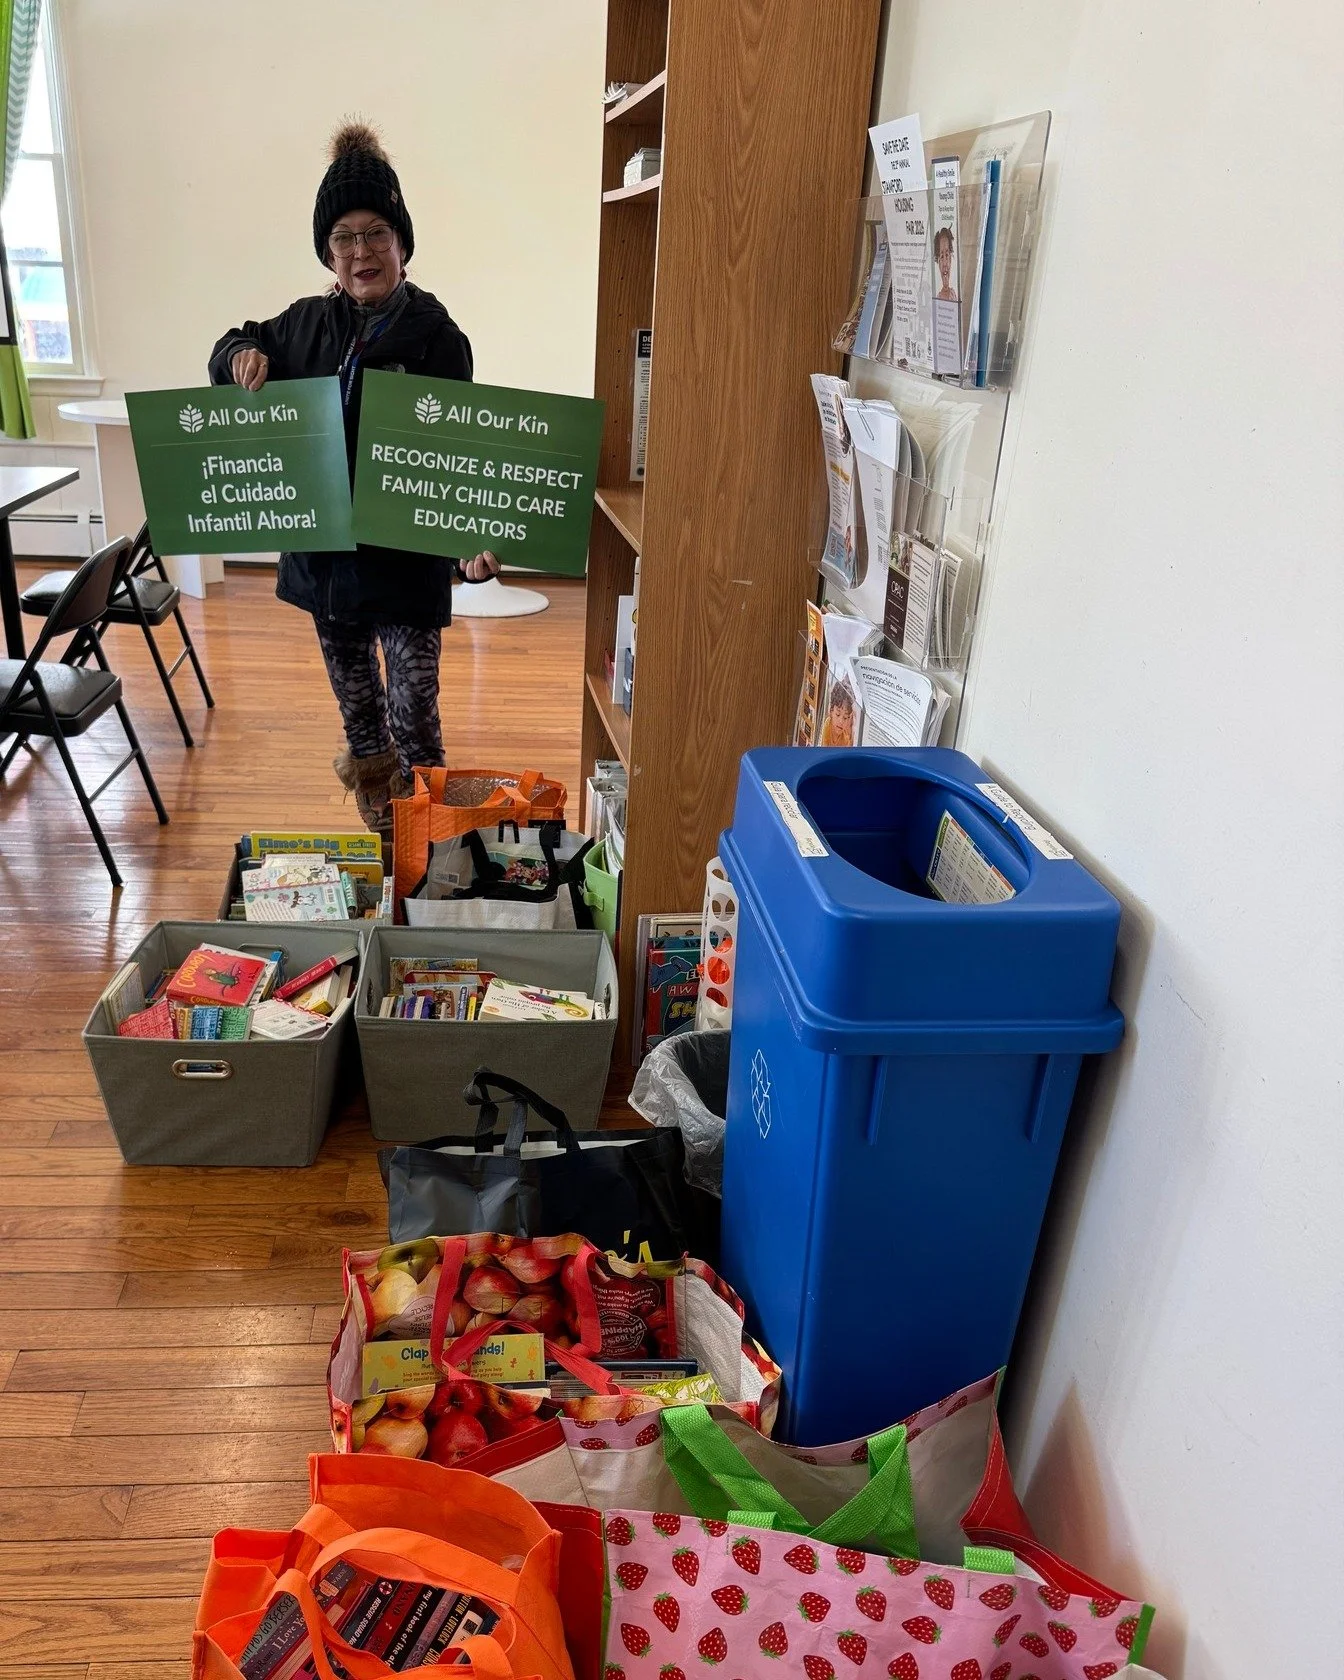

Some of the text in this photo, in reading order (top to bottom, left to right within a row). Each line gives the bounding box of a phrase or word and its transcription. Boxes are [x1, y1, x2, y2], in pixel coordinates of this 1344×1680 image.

[894, 197, 914, 213] HOUSING
[208, 405, 298, 427] All Our Kin
[446, 405, 549, 436] All Our Kin
[202, 453, 283, 480] ¡Financia
[371, 443, 583, 491] RECOGNIZE & RESPECT
[201, 481, 297, 505] el Cuidado
[381, 475, 566, 518] FAMILY CHILD CARE
[187, 509, 317, 534] Infantil Ahora!
[413, 508, 527, 541] EDUCATORS
[259, 838, 340, 850] Elmo's Big
[411, 1304, 434, 1315] RECYCLE
[401, 1347, 429, 1361] Clap
[422, 1589, 433, 1602] my
[366, 1597, 382, 1620] RESCUE
[415, 1601, 428, 1617] first
[277, 1625, 297, 1645] Love
[354, 1617, 369, 1638] SQUAD
[405, 1615, 420, 1634] book
[437, 1615, 459, 1645] LOVELOCK
[392, 1642, 404, 1656] the
[400, 1633, 408, 1644] of
